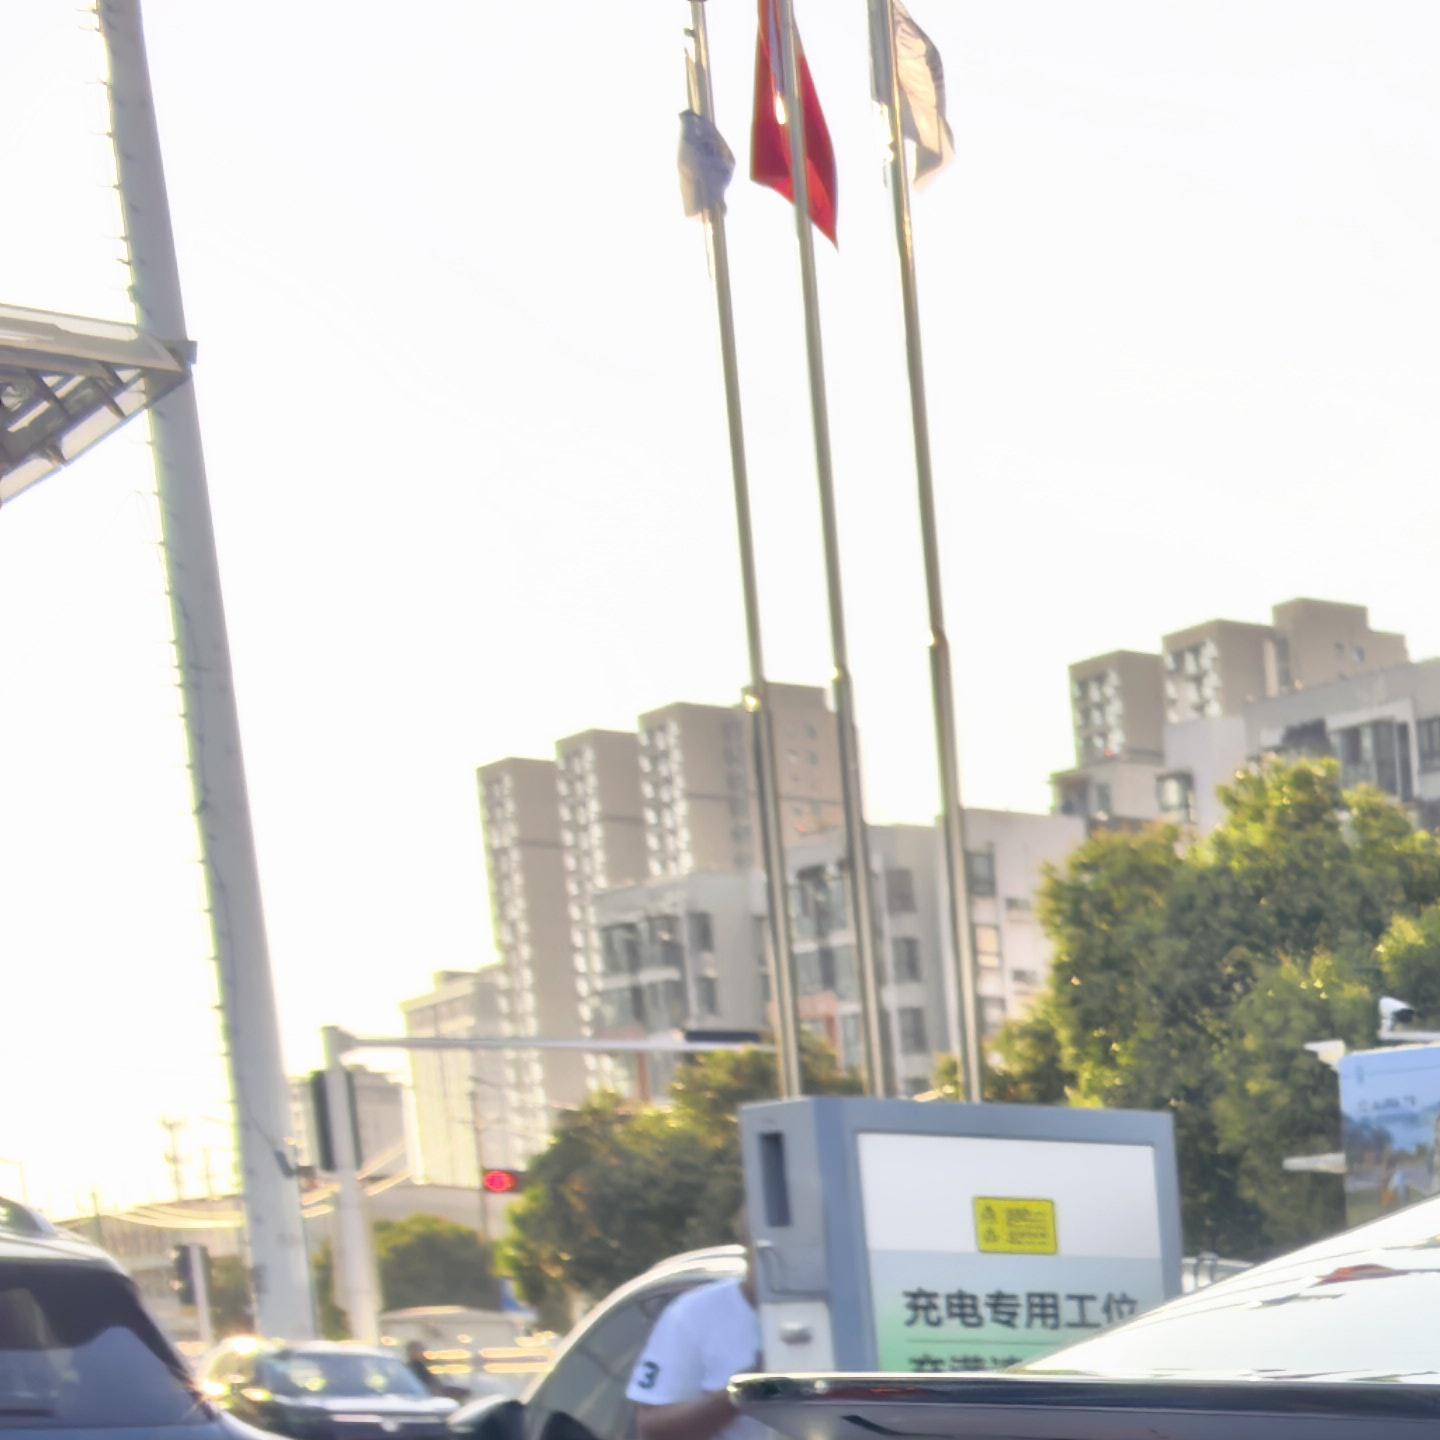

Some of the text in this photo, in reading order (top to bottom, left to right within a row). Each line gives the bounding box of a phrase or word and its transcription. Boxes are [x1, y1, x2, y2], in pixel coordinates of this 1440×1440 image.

[902, 1287, 1138, 1330] 充电专用工位
[638, 1361, 660, 1390] 3
